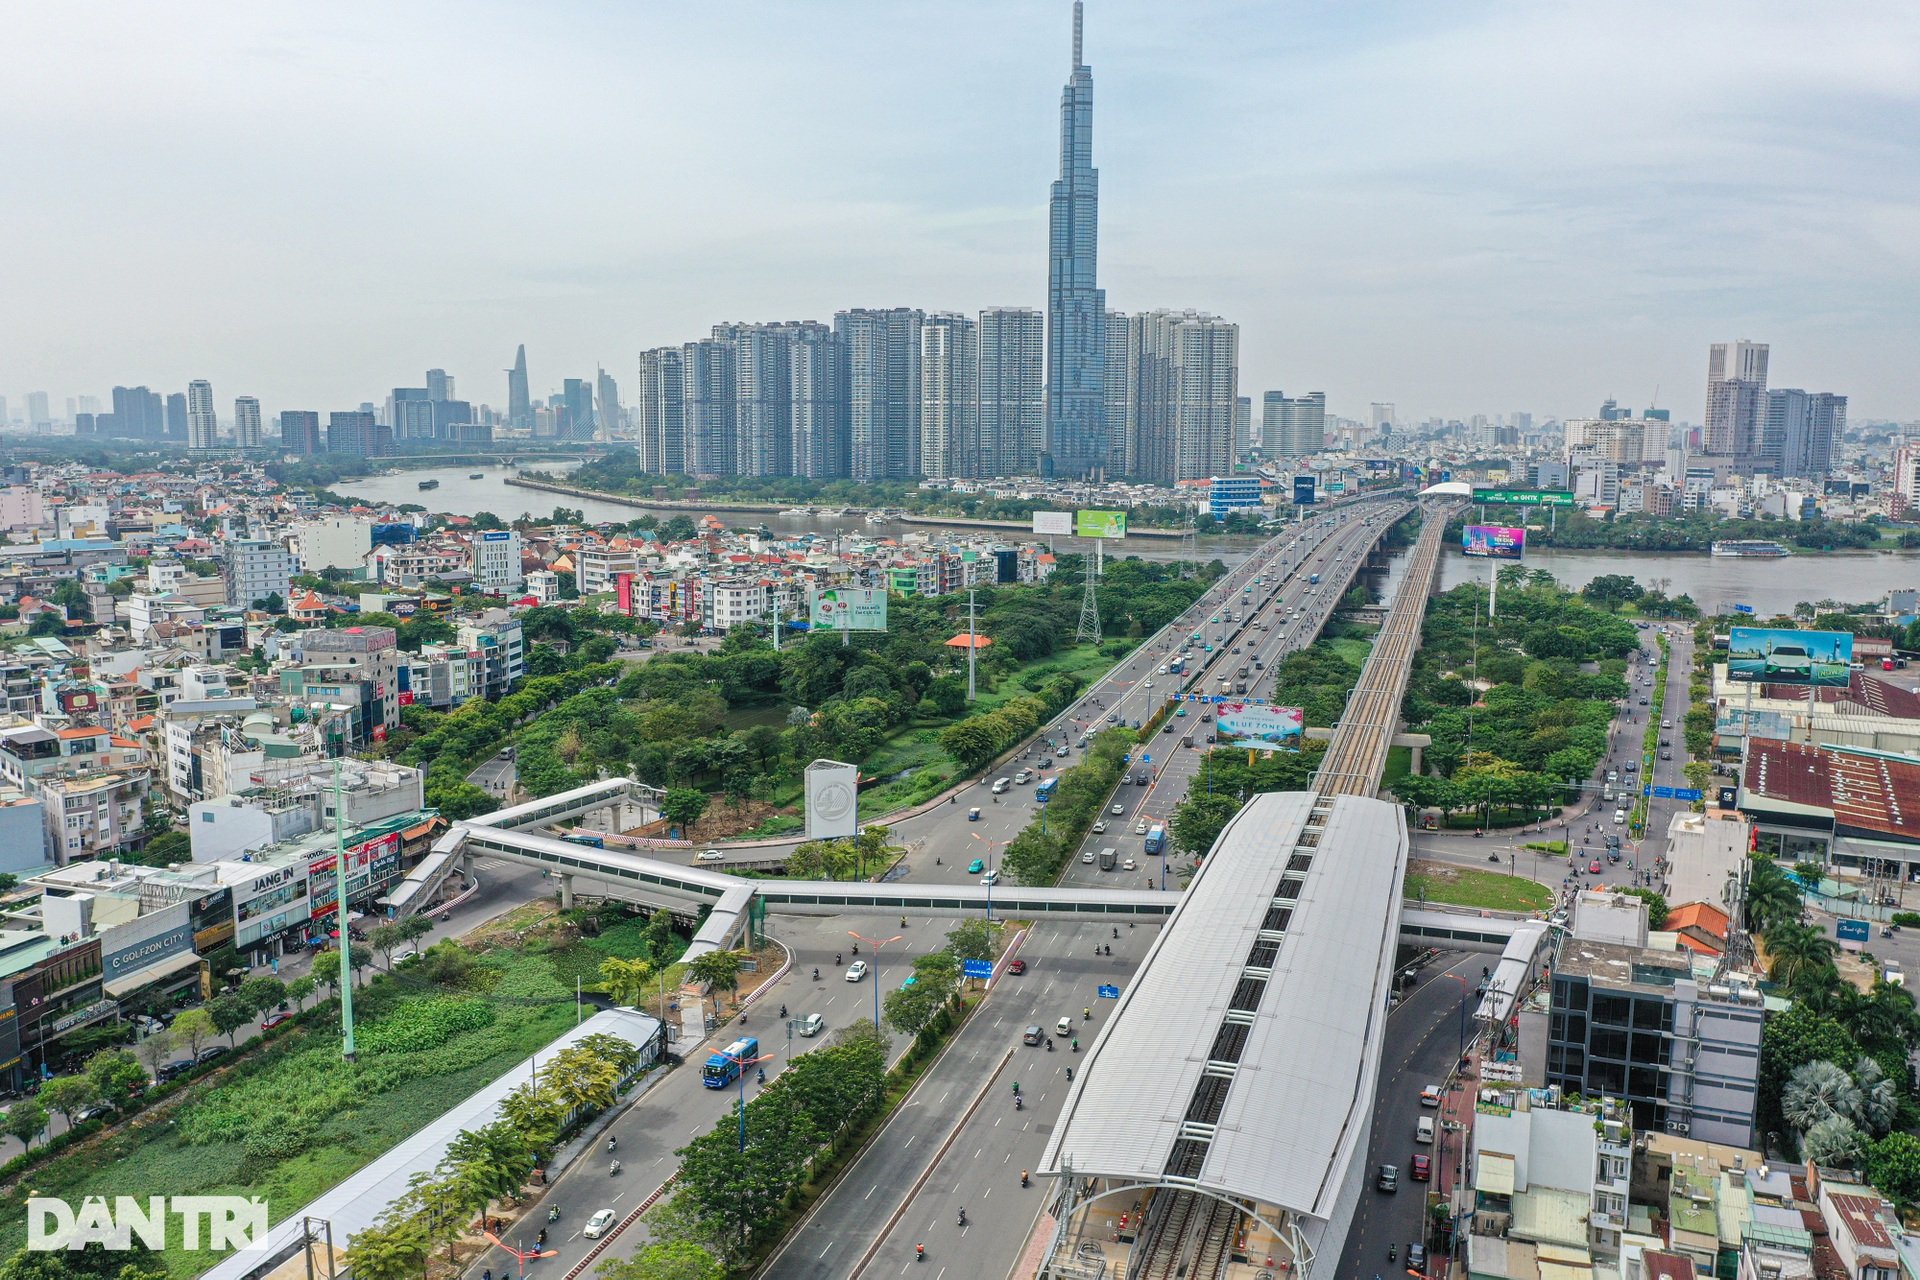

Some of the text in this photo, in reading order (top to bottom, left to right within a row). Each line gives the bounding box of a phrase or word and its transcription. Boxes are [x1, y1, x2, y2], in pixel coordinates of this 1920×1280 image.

[1256, 723, 1286, 731] ZONES
[252, 872, 281, 893] JANG
[283, 867, 294, 881] IN
[122, 932, 185, 963] GOLFZON CITY
[264, 929, 289, 945] JANG IN
